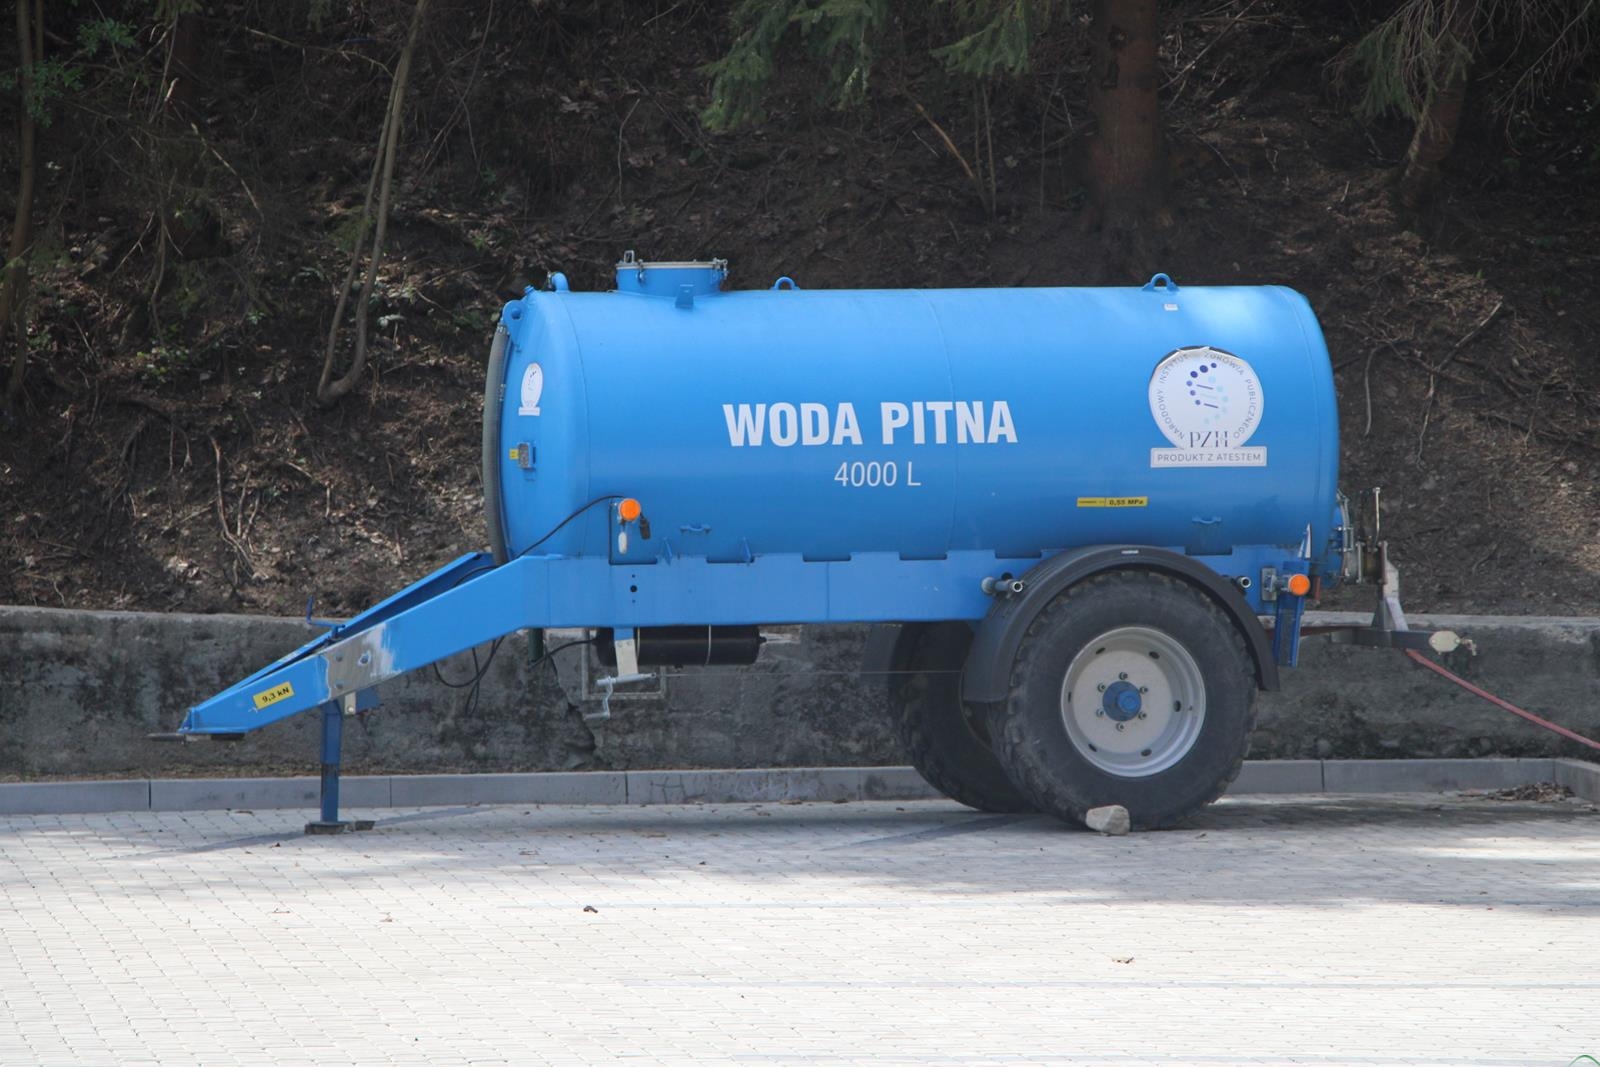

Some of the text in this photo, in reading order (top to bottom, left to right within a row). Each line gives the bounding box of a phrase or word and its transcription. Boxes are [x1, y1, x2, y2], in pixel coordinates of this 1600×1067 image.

[722, 400, 1018, 447] WODA PITNA
[1157, 389, 1185, 440] NARODOWY
[1189, 430, 1229, 448] PZH
[1157, 452, 1261, 462] PRODUKT Z ATESTEM
[834, 461, 922, 487] 4000 L
[262, 687, 290, 703] 9,3 kN
